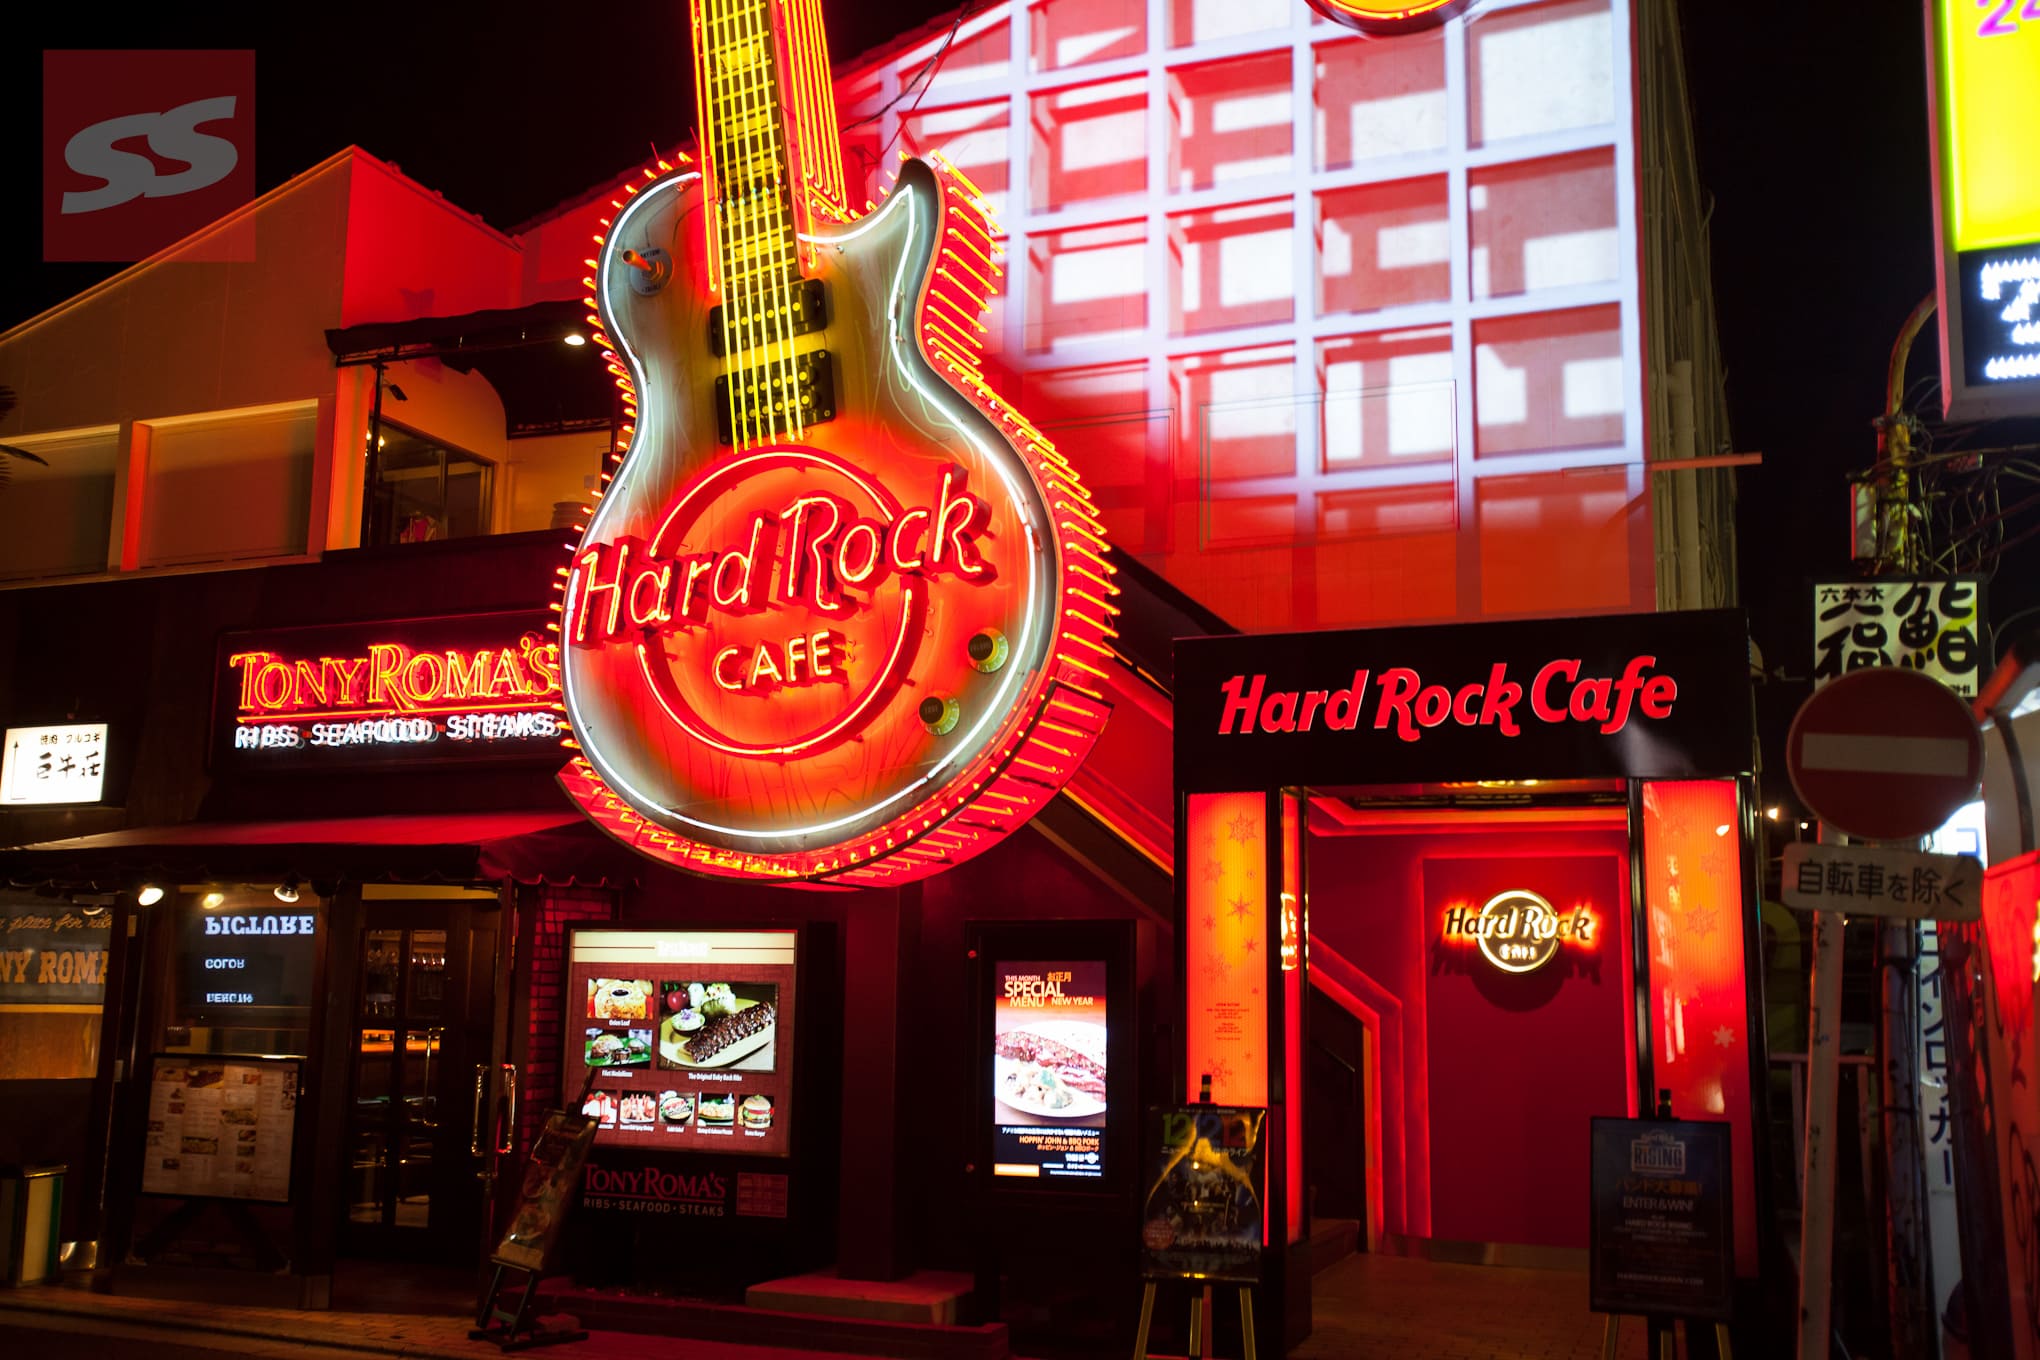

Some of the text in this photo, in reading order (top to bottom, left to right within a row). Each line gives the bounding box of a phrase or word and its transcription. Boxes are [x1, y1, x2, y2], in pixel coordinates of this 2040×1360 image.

[571, 464, 996, 646] Hard Rock
[1820, 586, 1884, 602] 六本木
[230, 637, 557, 711] TONY ROMA'S
[713, 630, 840, 691] CAFE
[1218, 655, 1677, 741] Hard Rock Cafe
[311, 718, 436, 747] SEAFOOD
[446, 712, 559, 740] STEAKS
[1797, 859, 1965, 906] 自転車を除く
[1445, 904, 1592, 942] Hard Rock
[1004, 981, 1064, 998] SPECIAL
[1010, 997, 1045, 1008] MENU
[1051, 997, 1093, 1006] NEW YEAR
[584, 1164, 642, 1191] TONY
[644, 1167, 726, 1199] ROMA'S
[584, 1197, 725, 1217] RIBS SEAFOOD STEAKS
